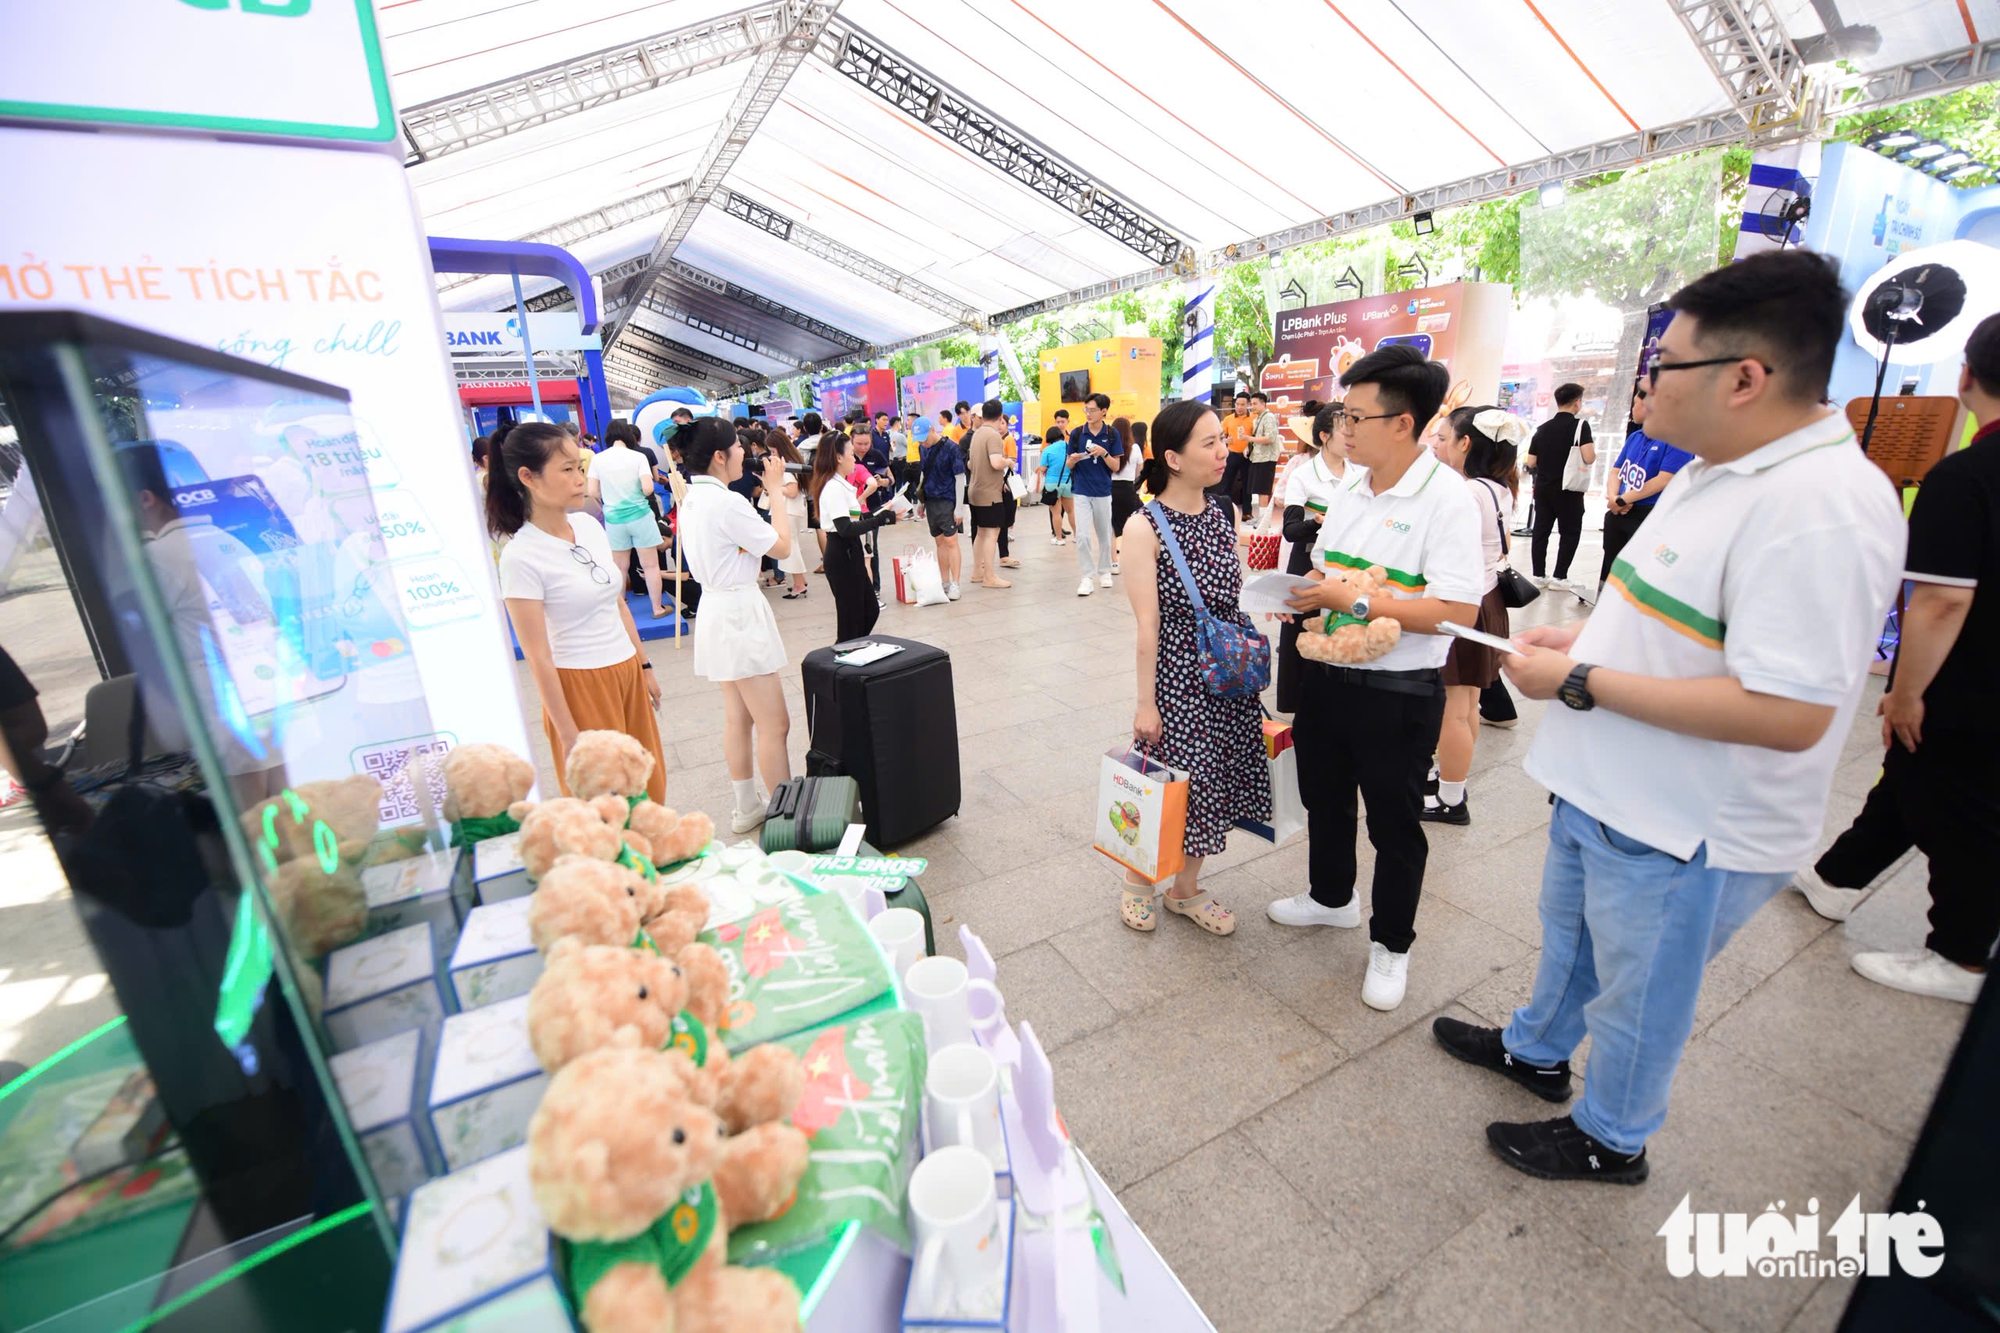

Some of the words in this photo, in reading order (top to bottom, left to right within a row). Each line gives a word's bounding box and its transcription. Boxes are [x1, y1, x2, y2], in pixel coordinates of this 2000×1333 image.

[64, 254, 171, 300] THẺ
[177, 258, 290, 302] TÍCH
[295, 254, 385, 302] TẮC
[1282, 314, 1322, 332] LPBank
[1323, 312, 1348, 326] Plus
[1362, 308, 1391, 321] LPBank
[314, 320, 402, 357] chill
[1265, 372, 1284, 381] SIMPLE
[1618, 460, 1644, 490] ACB
[176, 488, 217, 505] OCB
[380, 521, 426, 539] 50%
[1393, 521, 1411, 532] OCB
[406, 580, 460, 600] 100%
[1113, 773, 1143, 797] HDBank
